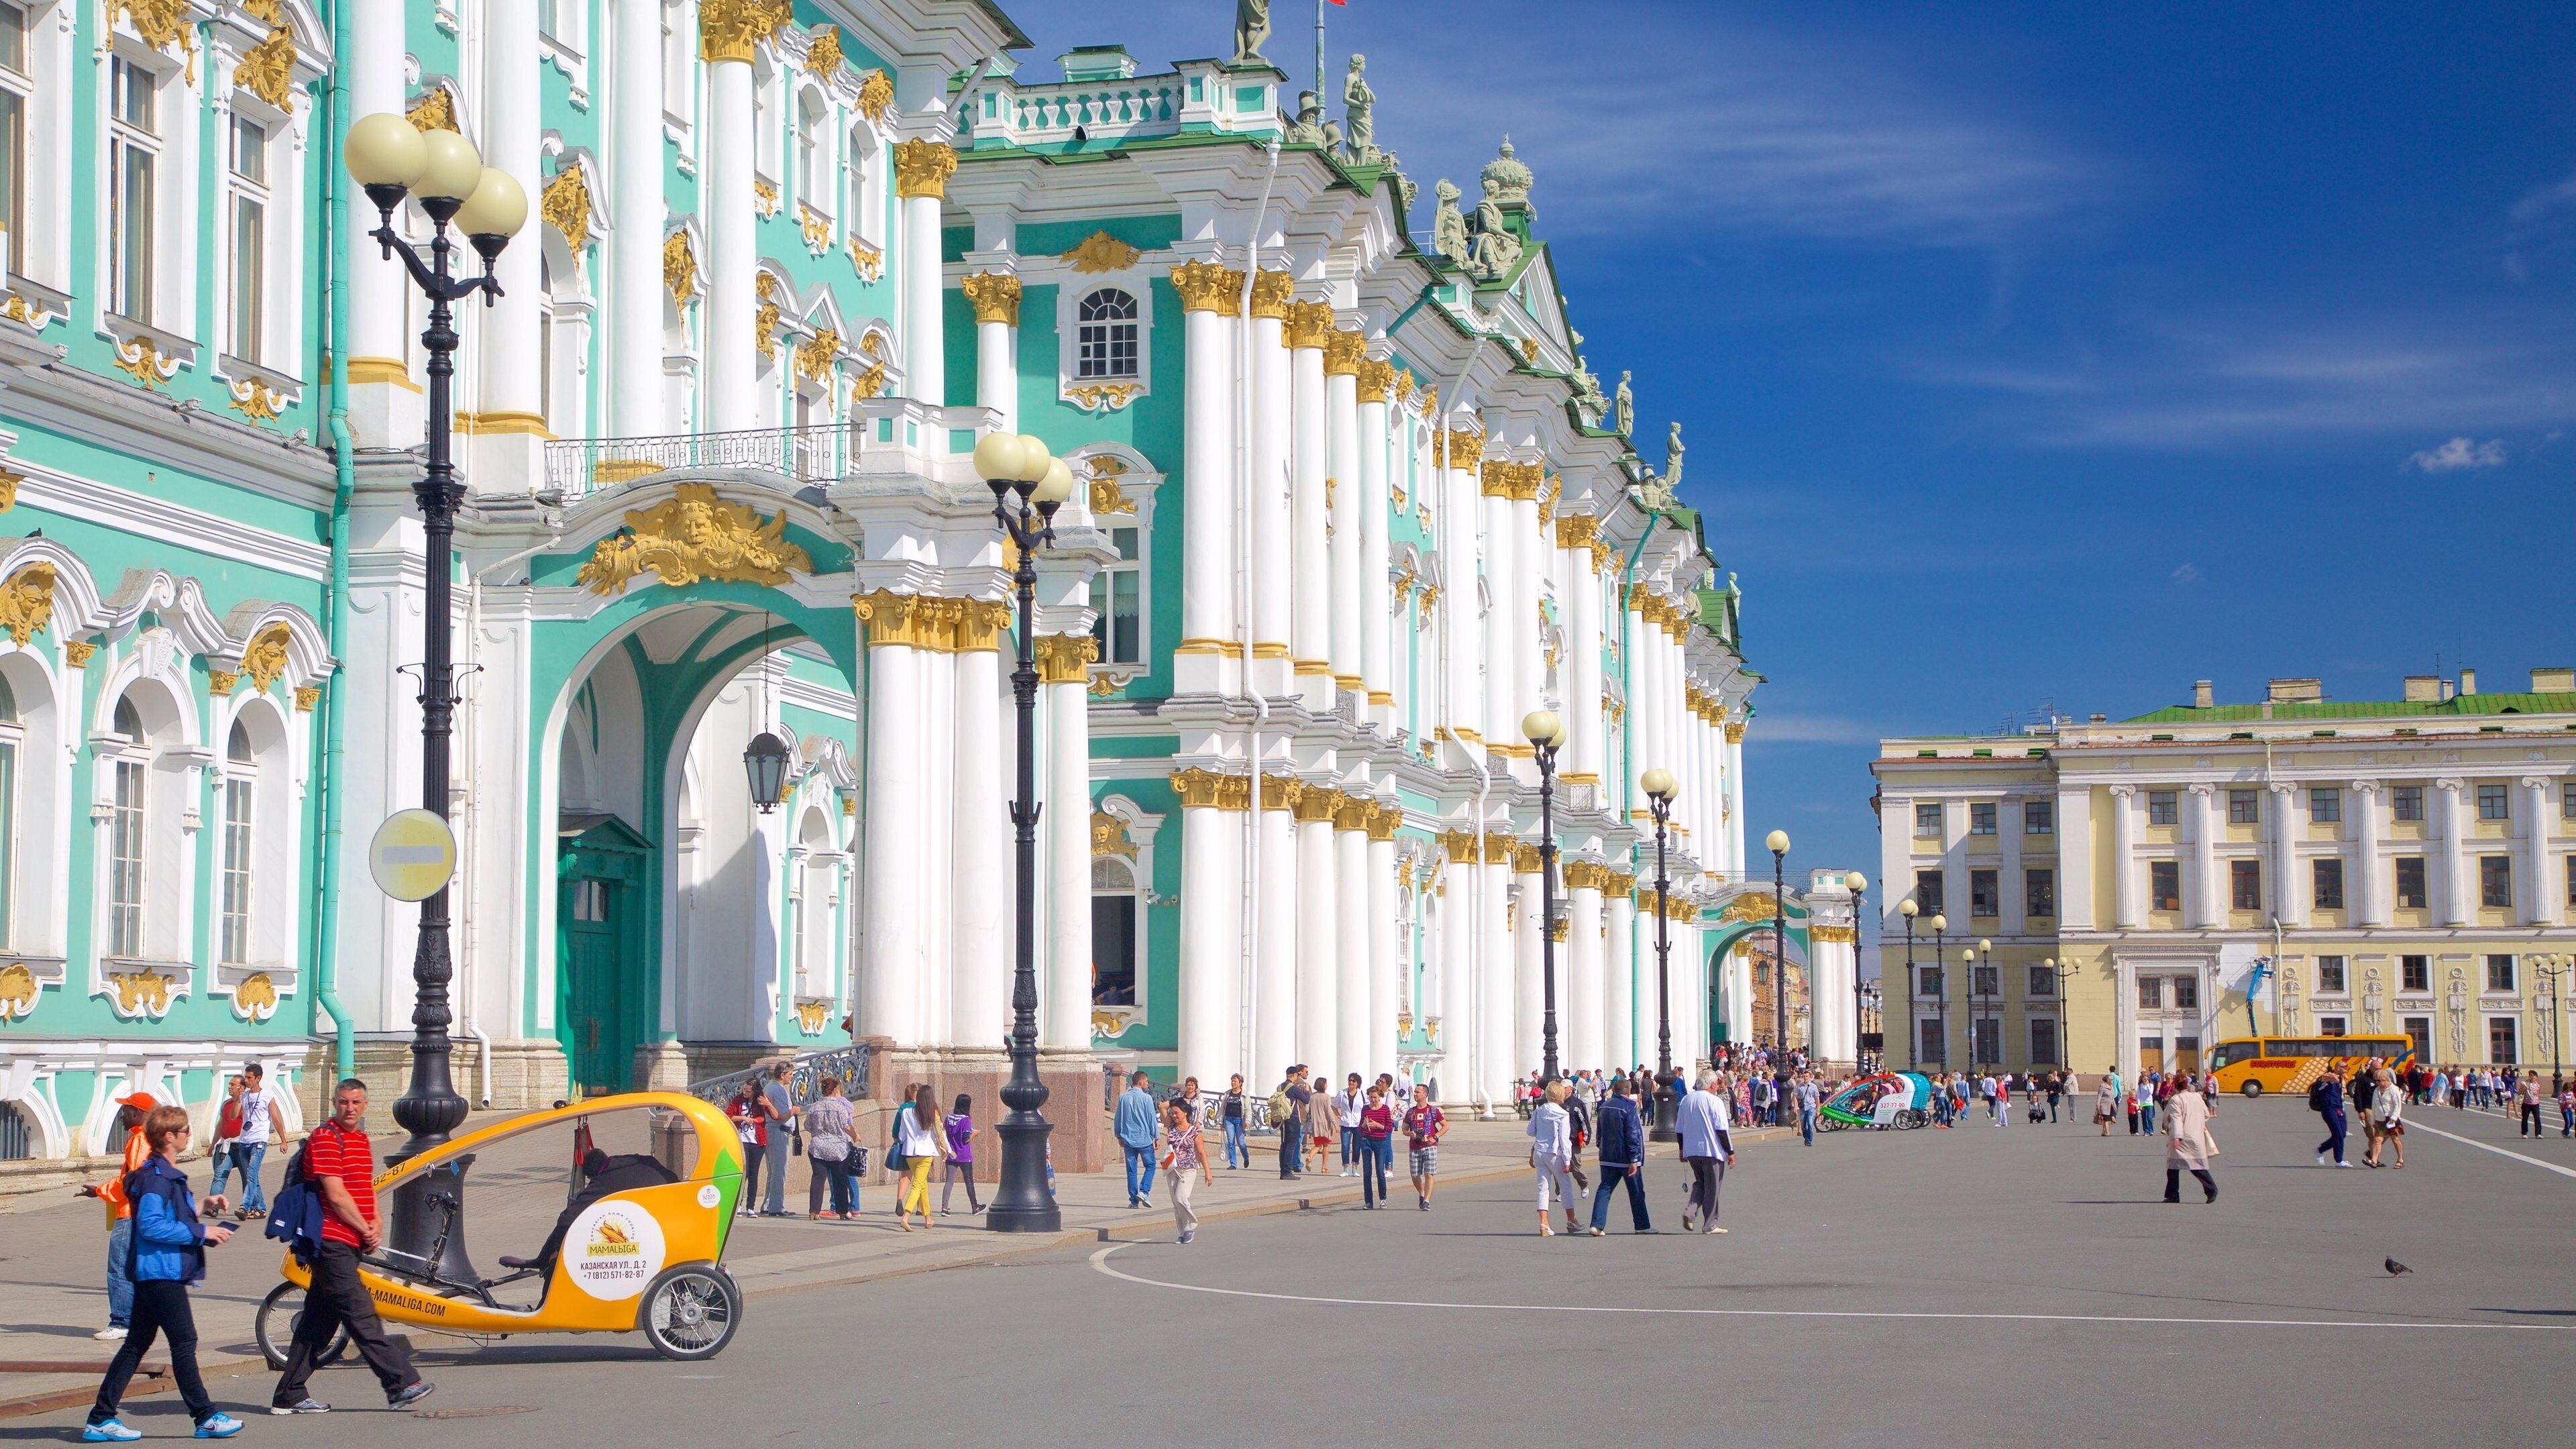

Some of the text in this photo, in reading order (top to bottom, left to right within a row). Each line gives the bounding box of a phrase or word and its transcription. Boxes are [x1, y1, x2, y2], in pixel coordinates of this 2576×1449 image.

[580, 1262, 618, 1271] КАЗАНСКАЯ
[593, 1271, 609, 1279] (812)
[610, 1270, 644, 1279] 571-82-87
